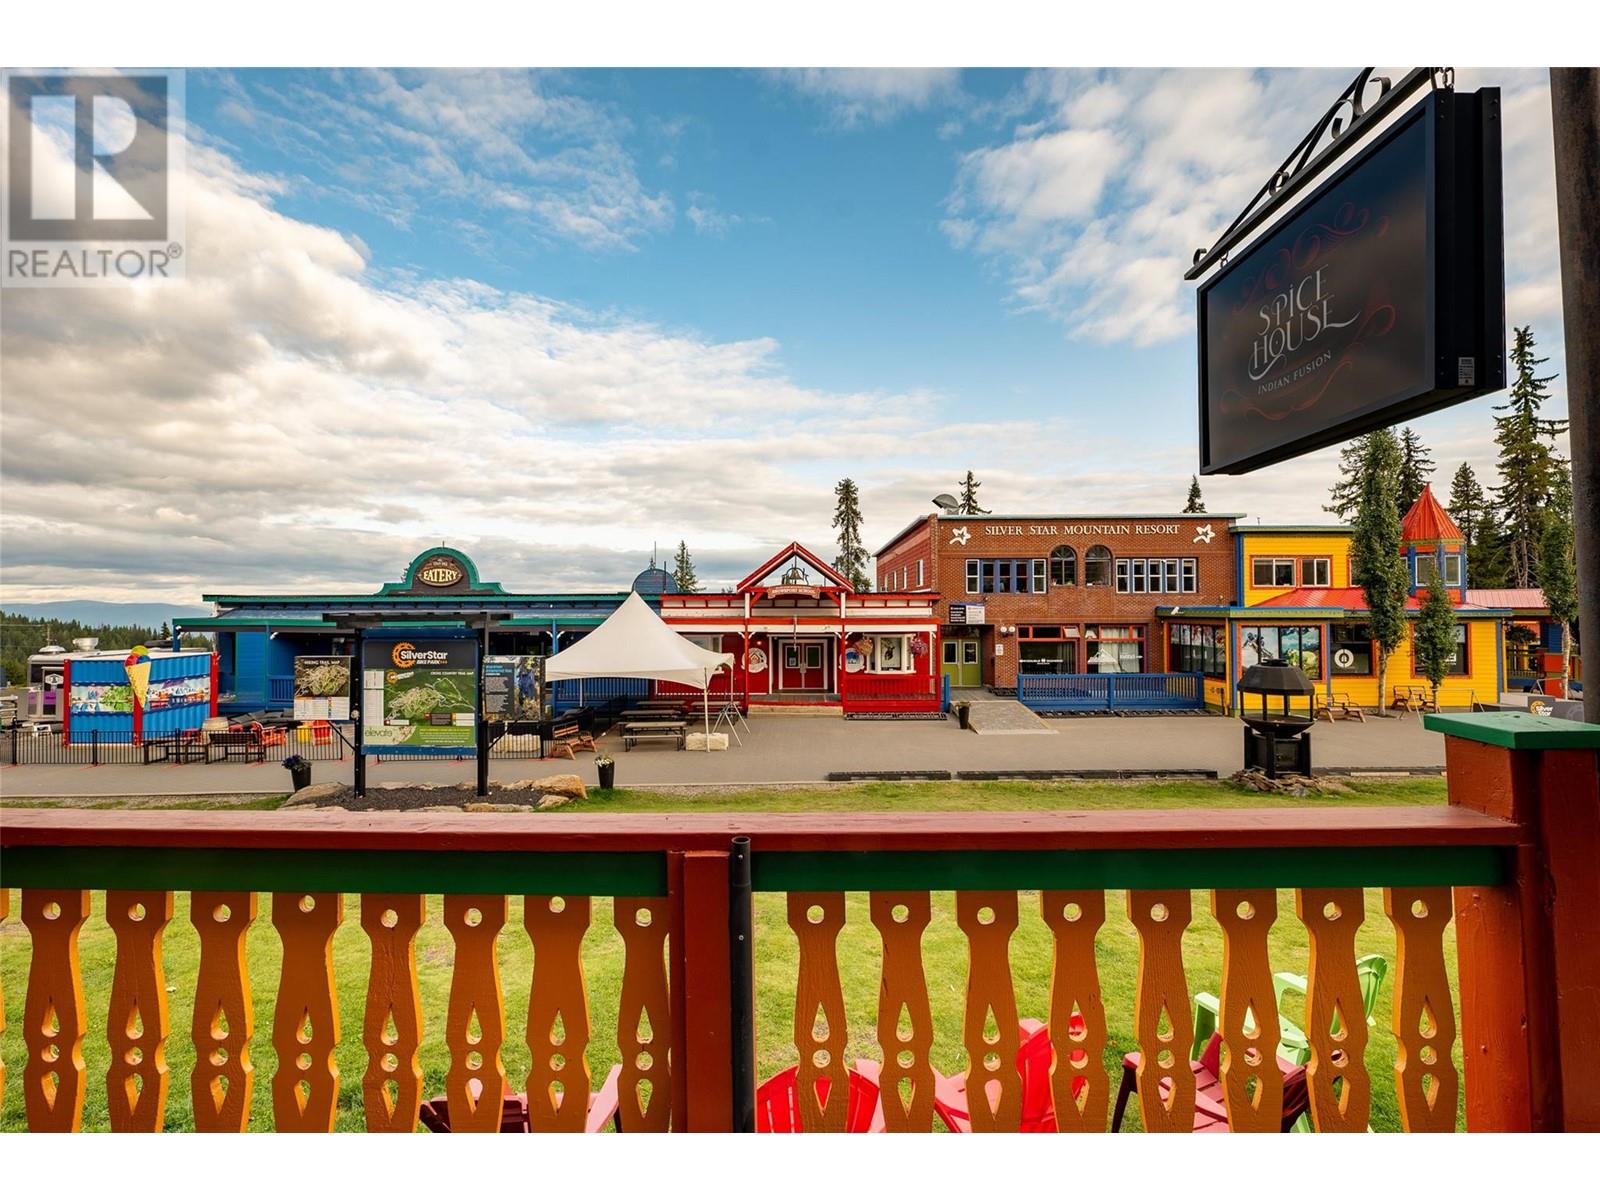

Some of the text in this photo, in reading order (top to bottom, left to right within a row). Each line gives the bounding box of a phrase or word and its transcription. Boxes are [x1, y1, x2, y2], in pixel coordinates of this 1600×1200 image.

[1257, 263, 1329, 336] SPICE
[1248, 294, 1361, 381] HOUSE
[1257, 350, 1332, 395] INDIAN FUSION
[985, 524, 1181, 535] SILVER STAR MOUNTAIN RESORT
[423, 568, 458, 582] EATERY
[400, 650, 448, 660] SilverStar
[364, 727, 393, 738] elevate
